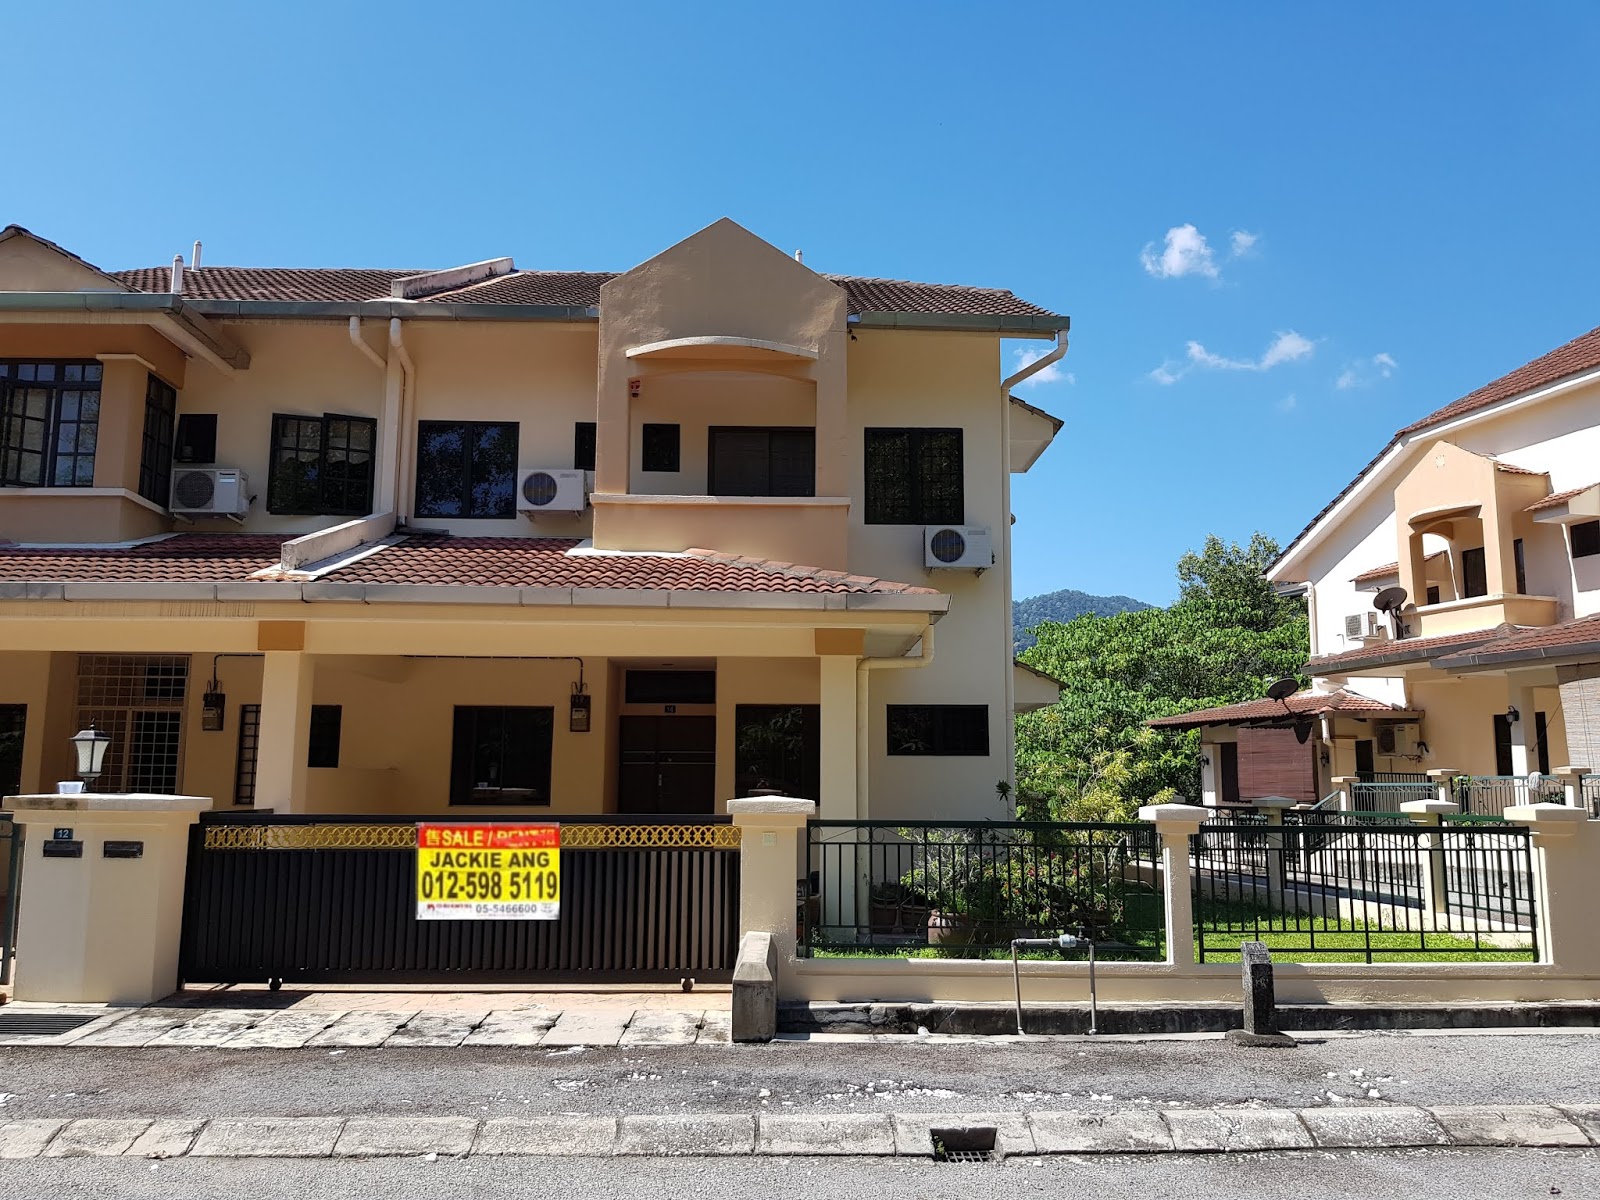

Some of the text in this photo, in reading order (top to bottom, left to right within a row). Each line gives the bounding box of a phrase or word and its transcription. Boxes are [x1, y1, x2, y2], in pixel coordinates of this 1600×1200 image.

[57, 829, 69, 838] 12
[442, 829, 484, 847] SALE
[430, 852, 550, 868] JACKIE ANG
[422, 871, 557, 899] 012-598 5119
[476, 904, 537, 914] 05-5466600
